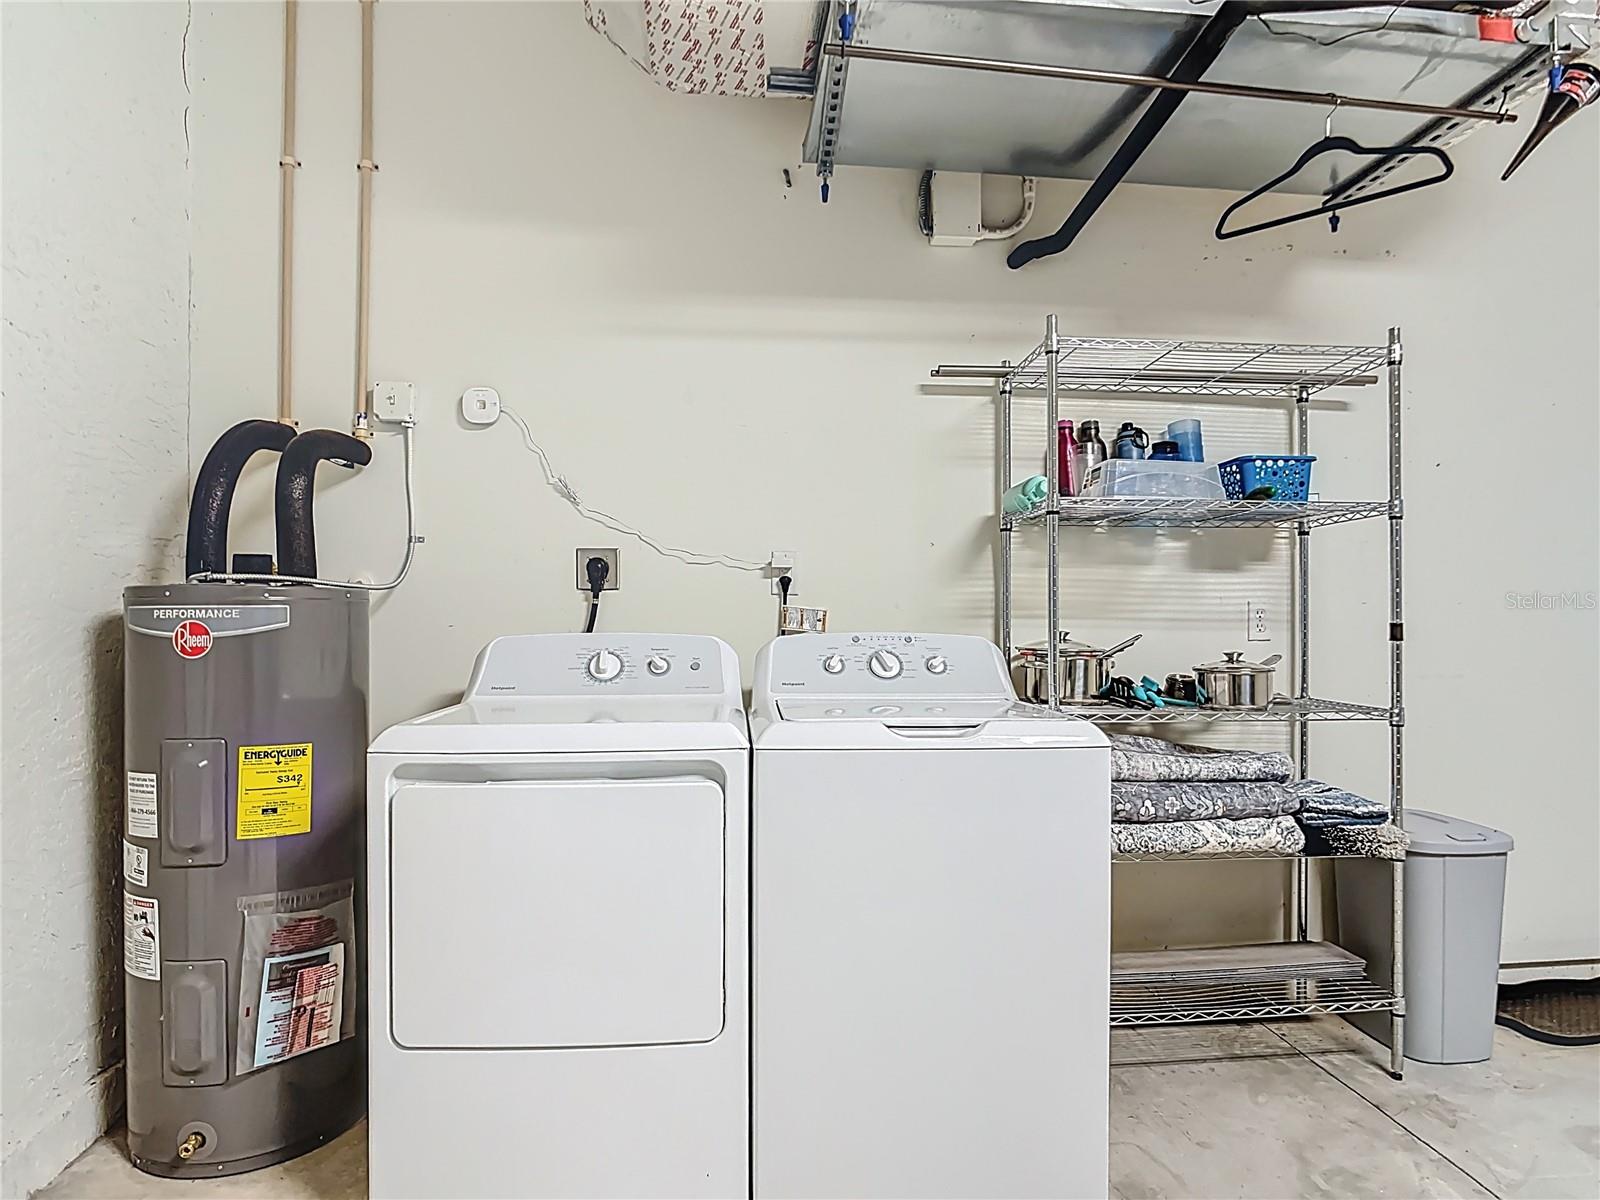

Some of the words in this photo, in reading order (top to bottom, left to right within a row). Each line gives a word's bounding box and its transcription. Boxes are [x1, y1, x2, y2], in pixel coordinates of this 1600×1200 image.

[153, 609, 240, 618] PERFORMANCE
[177, 621, 210, 652] Rheem
[244, 748, 308, 760] ENERGYGUIDE
